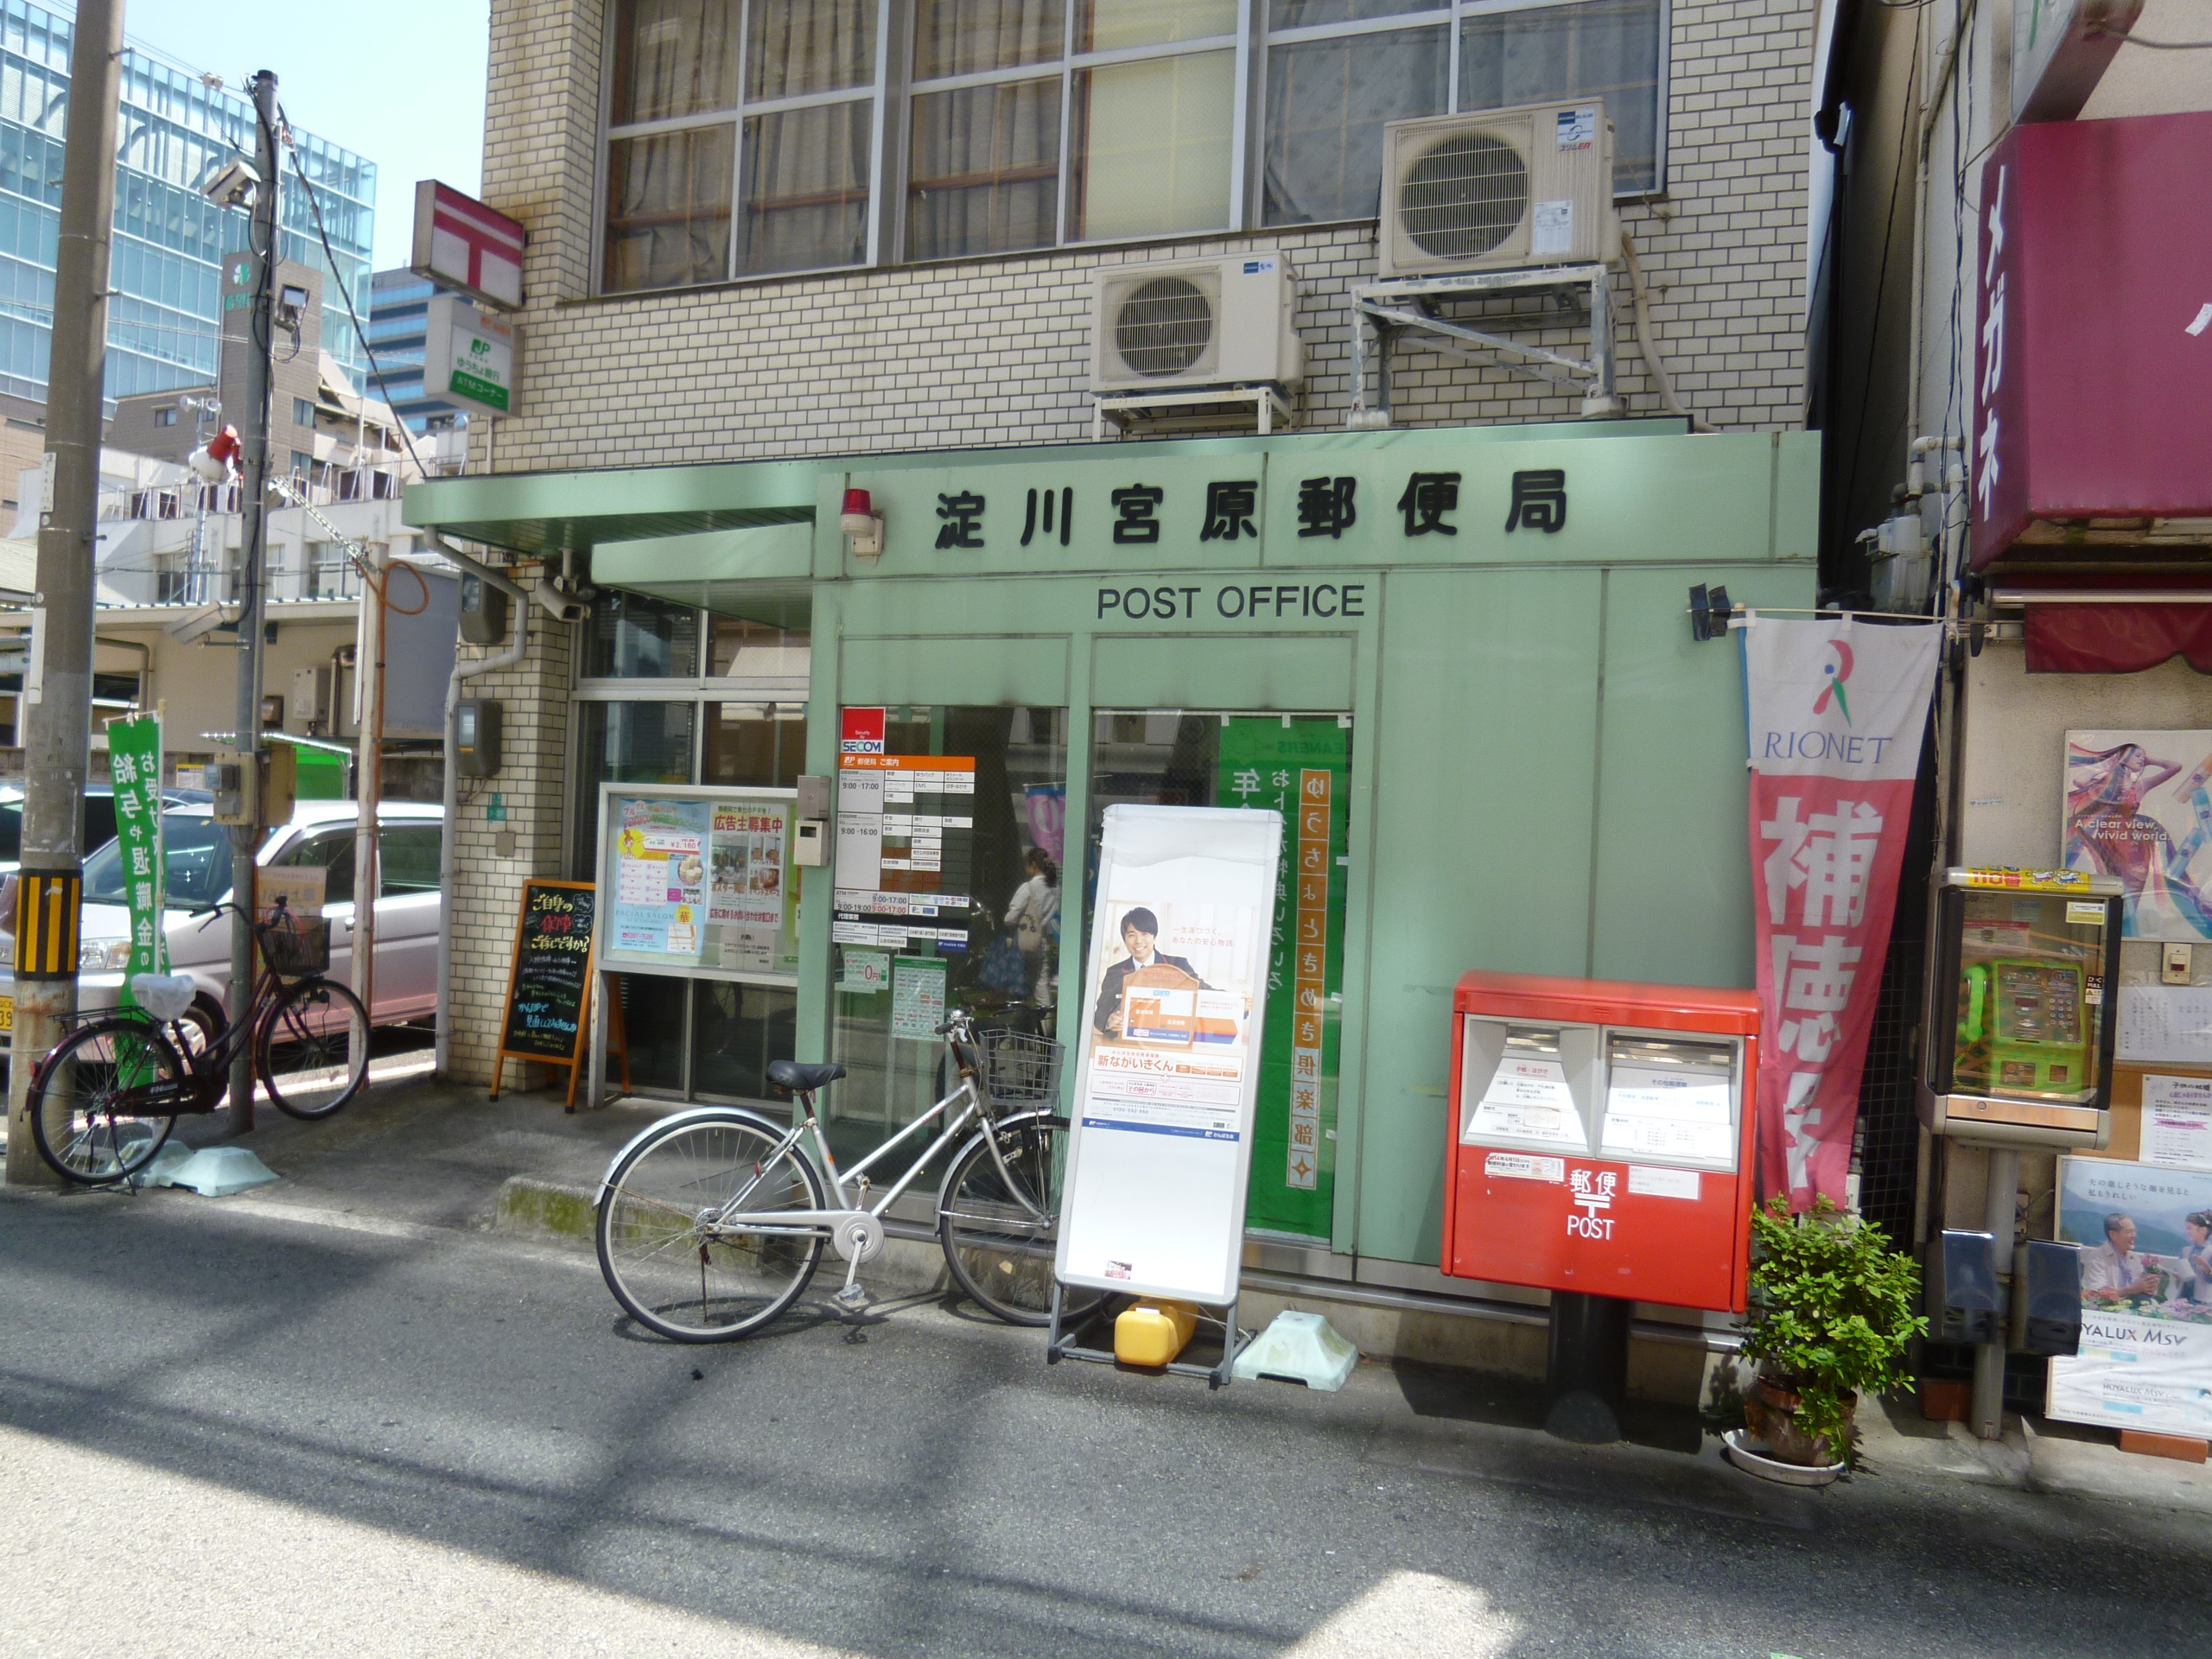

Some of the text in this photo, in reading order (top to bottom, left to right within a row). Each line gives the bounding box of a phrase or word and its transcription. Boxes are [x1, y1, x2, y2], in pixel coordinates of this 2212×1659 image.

[1979, 164, 2005, 522] メガネ
[457, 356, 500, 382] ゆうちょ銀行
[935, 469, 1566, 550] 淀川宮原郵便局
[1096, 584, 1365, 620] POST OFFICE
[843, 741, 881, 753] SECOM
[1764, 730, 1892, 765] RIONET
[880, 759, 899, 767] ご案内
[714, 815, 783, 834] 広告主募集中
[2088, 818, 2122, 829] clear
[2097, 830, 2171, 842] vivid world.
[1972, 871, 2021, 887] 110番
[532, 893, 573, 912] ご自身の
[646, 912, 674, 920] SALON
[1097, 1055, 1173, 1072] 新ながいきくん
[1570, 1168, 1618, 1198] 郵便
[2089, 1179, 2190, 1196] 夫の楽しそうな顔を見ると
[1567, 1215, 1615, 1241] POST
[2081, 1322, 2138, 1342] YALUX
[2103, 1383, 2142, 1395] HOYALUX
